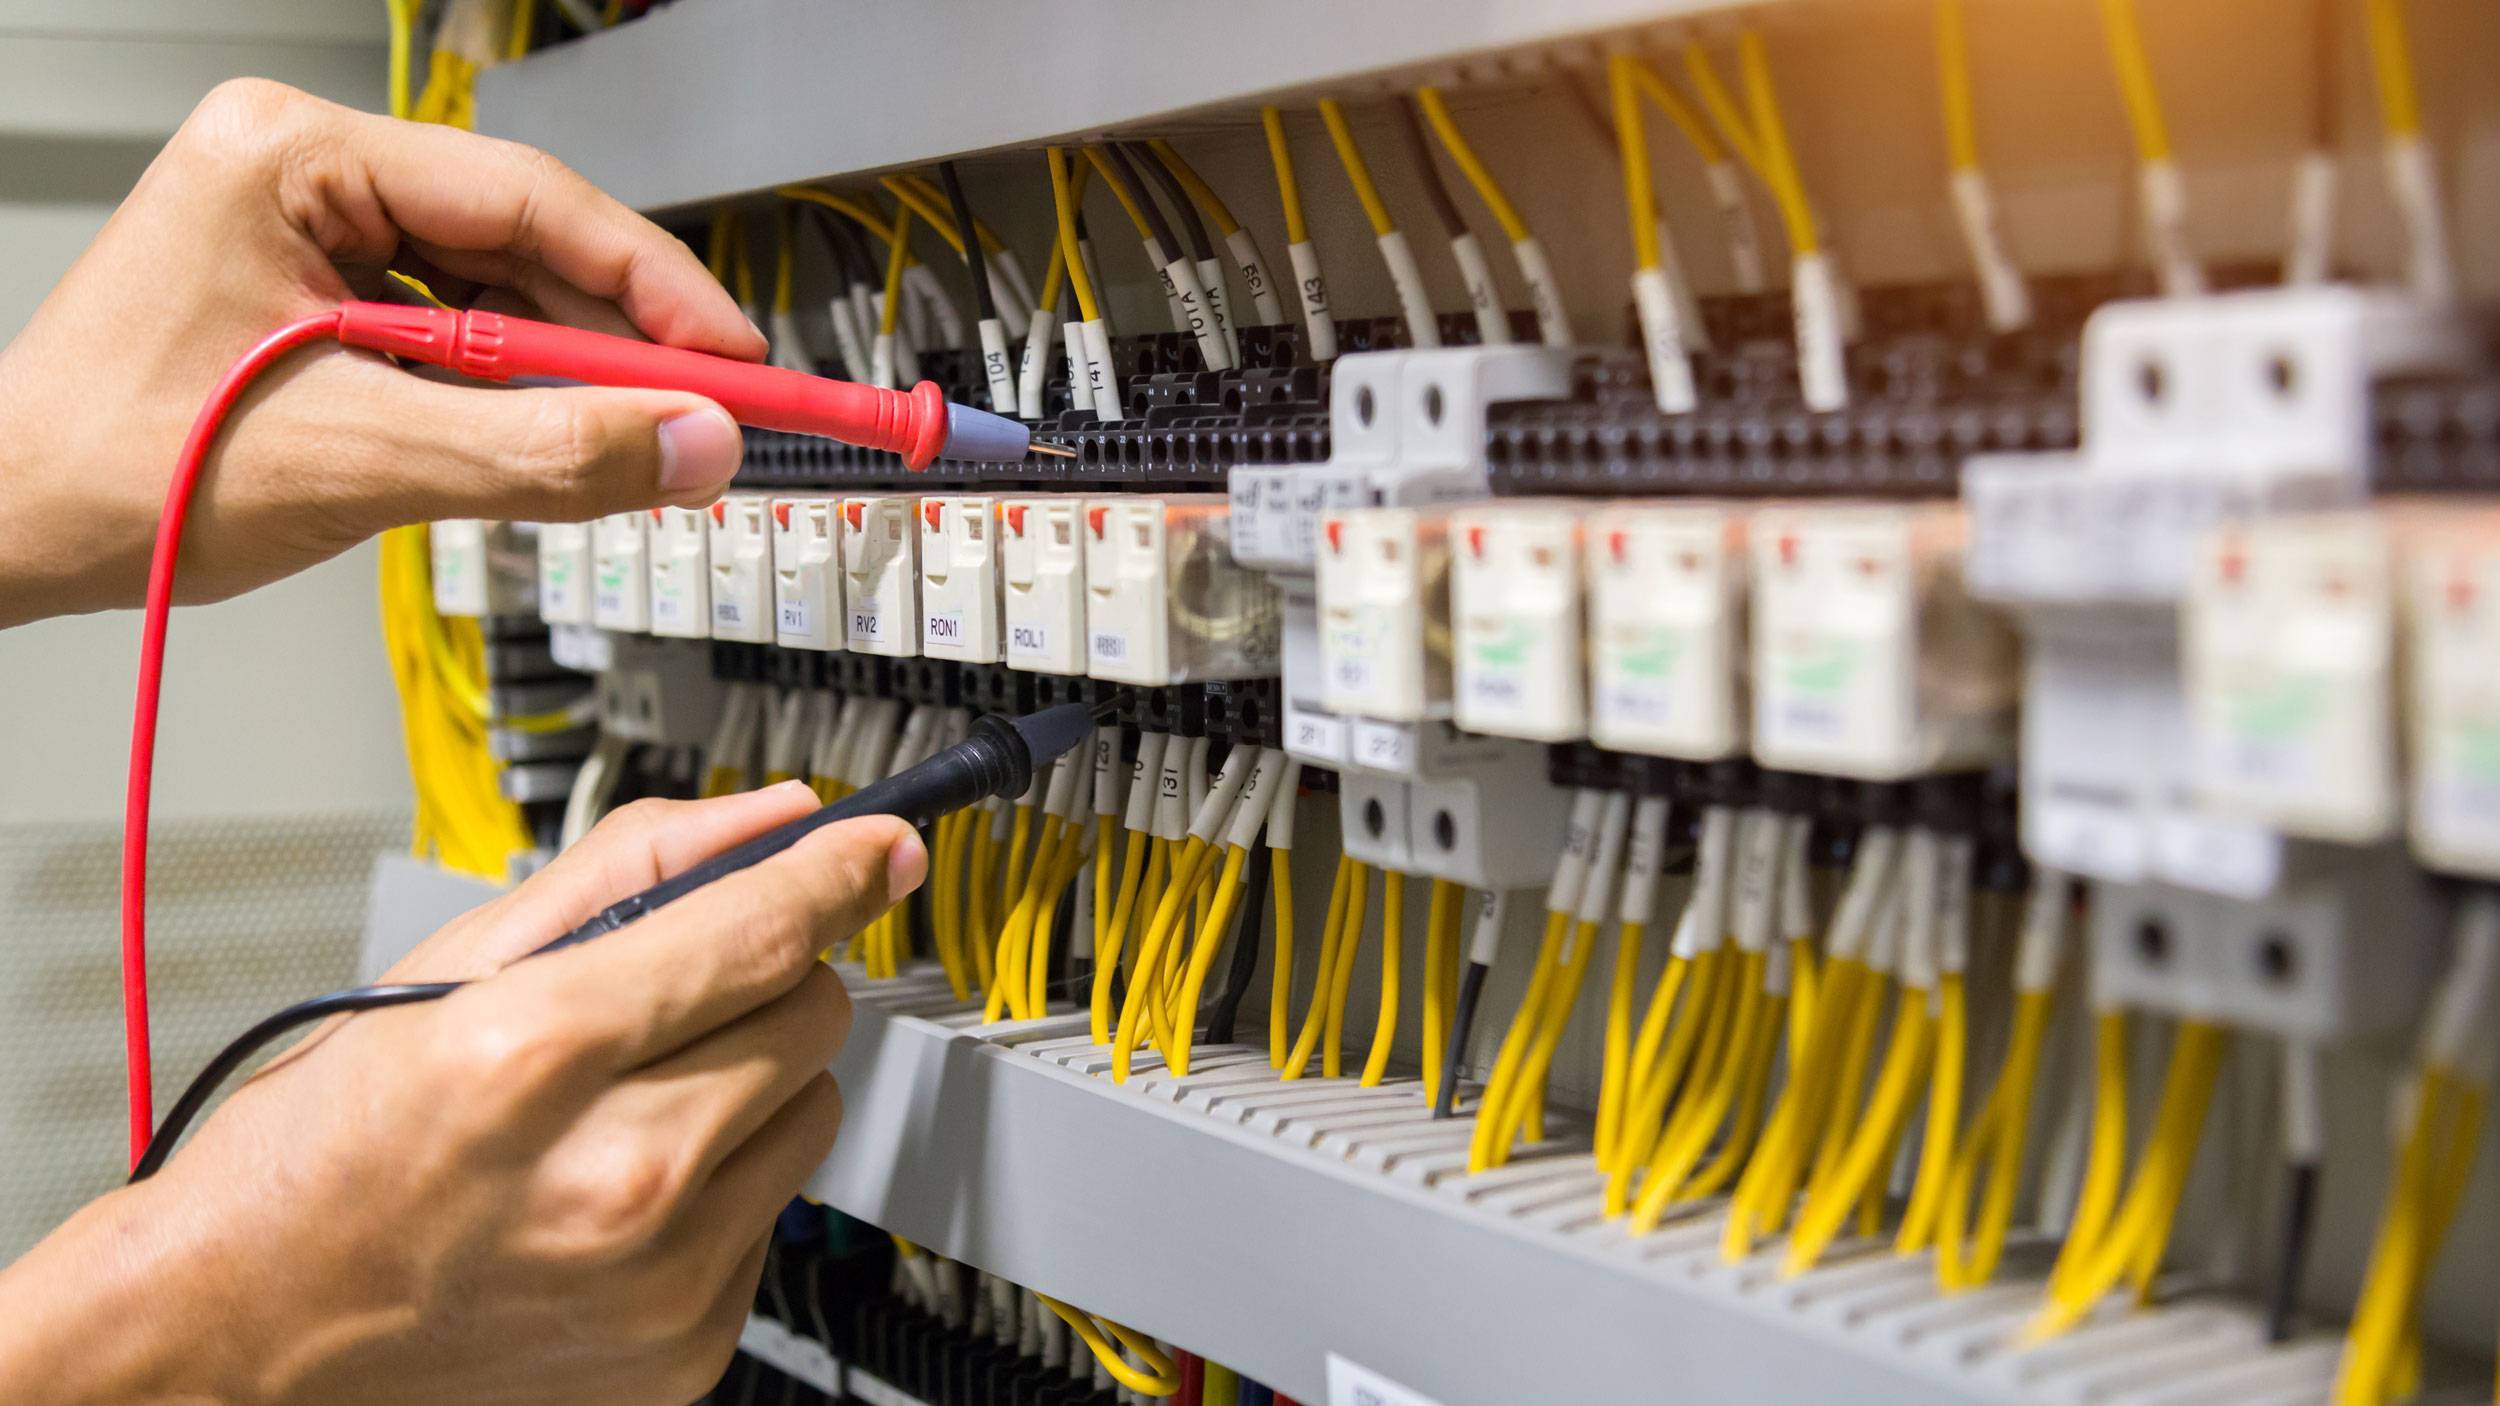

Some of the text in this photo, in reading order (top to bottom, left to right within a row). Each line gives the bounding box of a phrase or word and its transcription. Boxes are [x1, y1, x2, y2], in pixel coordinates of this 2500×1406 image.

[1304, 277, 1329, 316] 143
[1181, 291, 1208, 339] 101A
[987, 351, 1006, 384] 104
[785, 609, 802, 627] RV1
[856, 615, 877, 633] RV2
[930, 618, 958, 637] RON1
[1162, 767, 1178, 798] 131
